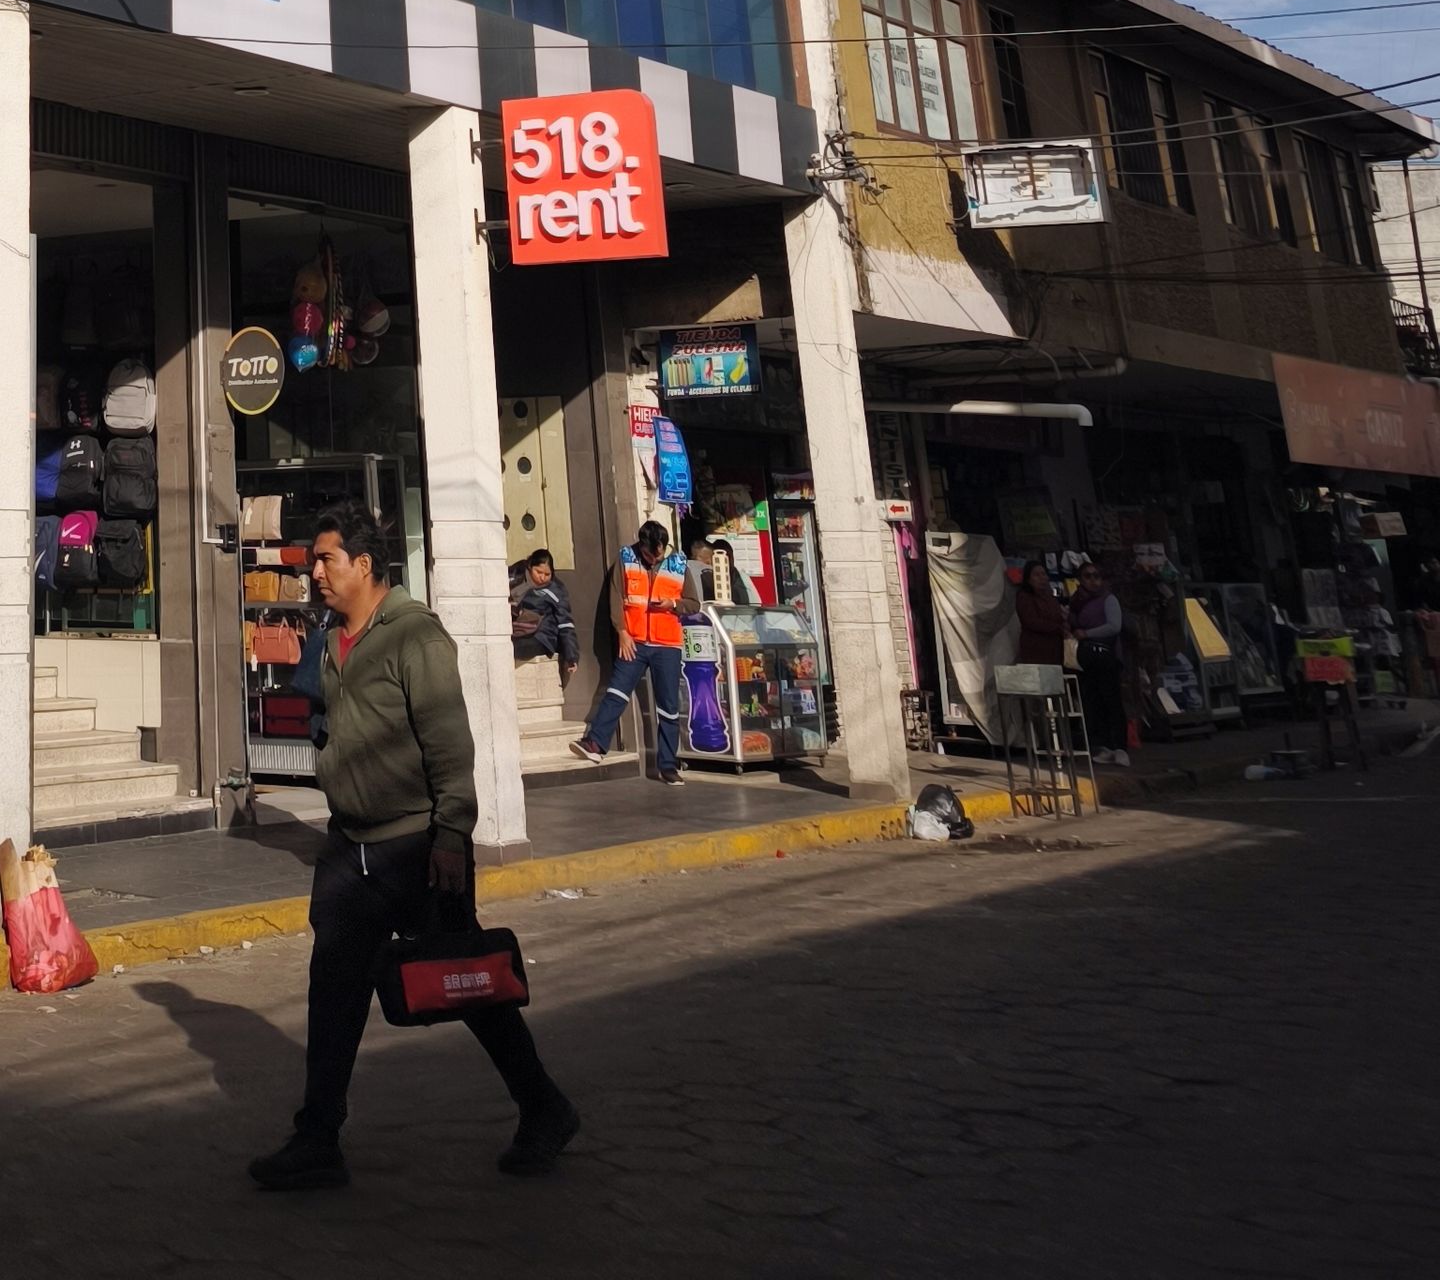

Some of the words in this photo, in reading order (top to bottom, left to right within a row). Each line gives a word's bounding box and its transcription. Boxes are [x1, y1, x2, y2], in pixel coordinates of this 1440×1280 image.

[512, 111, 641, 182] 518.
[517, 172, 645, 241] rent
[676, 326, 742, 344] TIENDA
[228, 355, 278, 377] TOTTO
